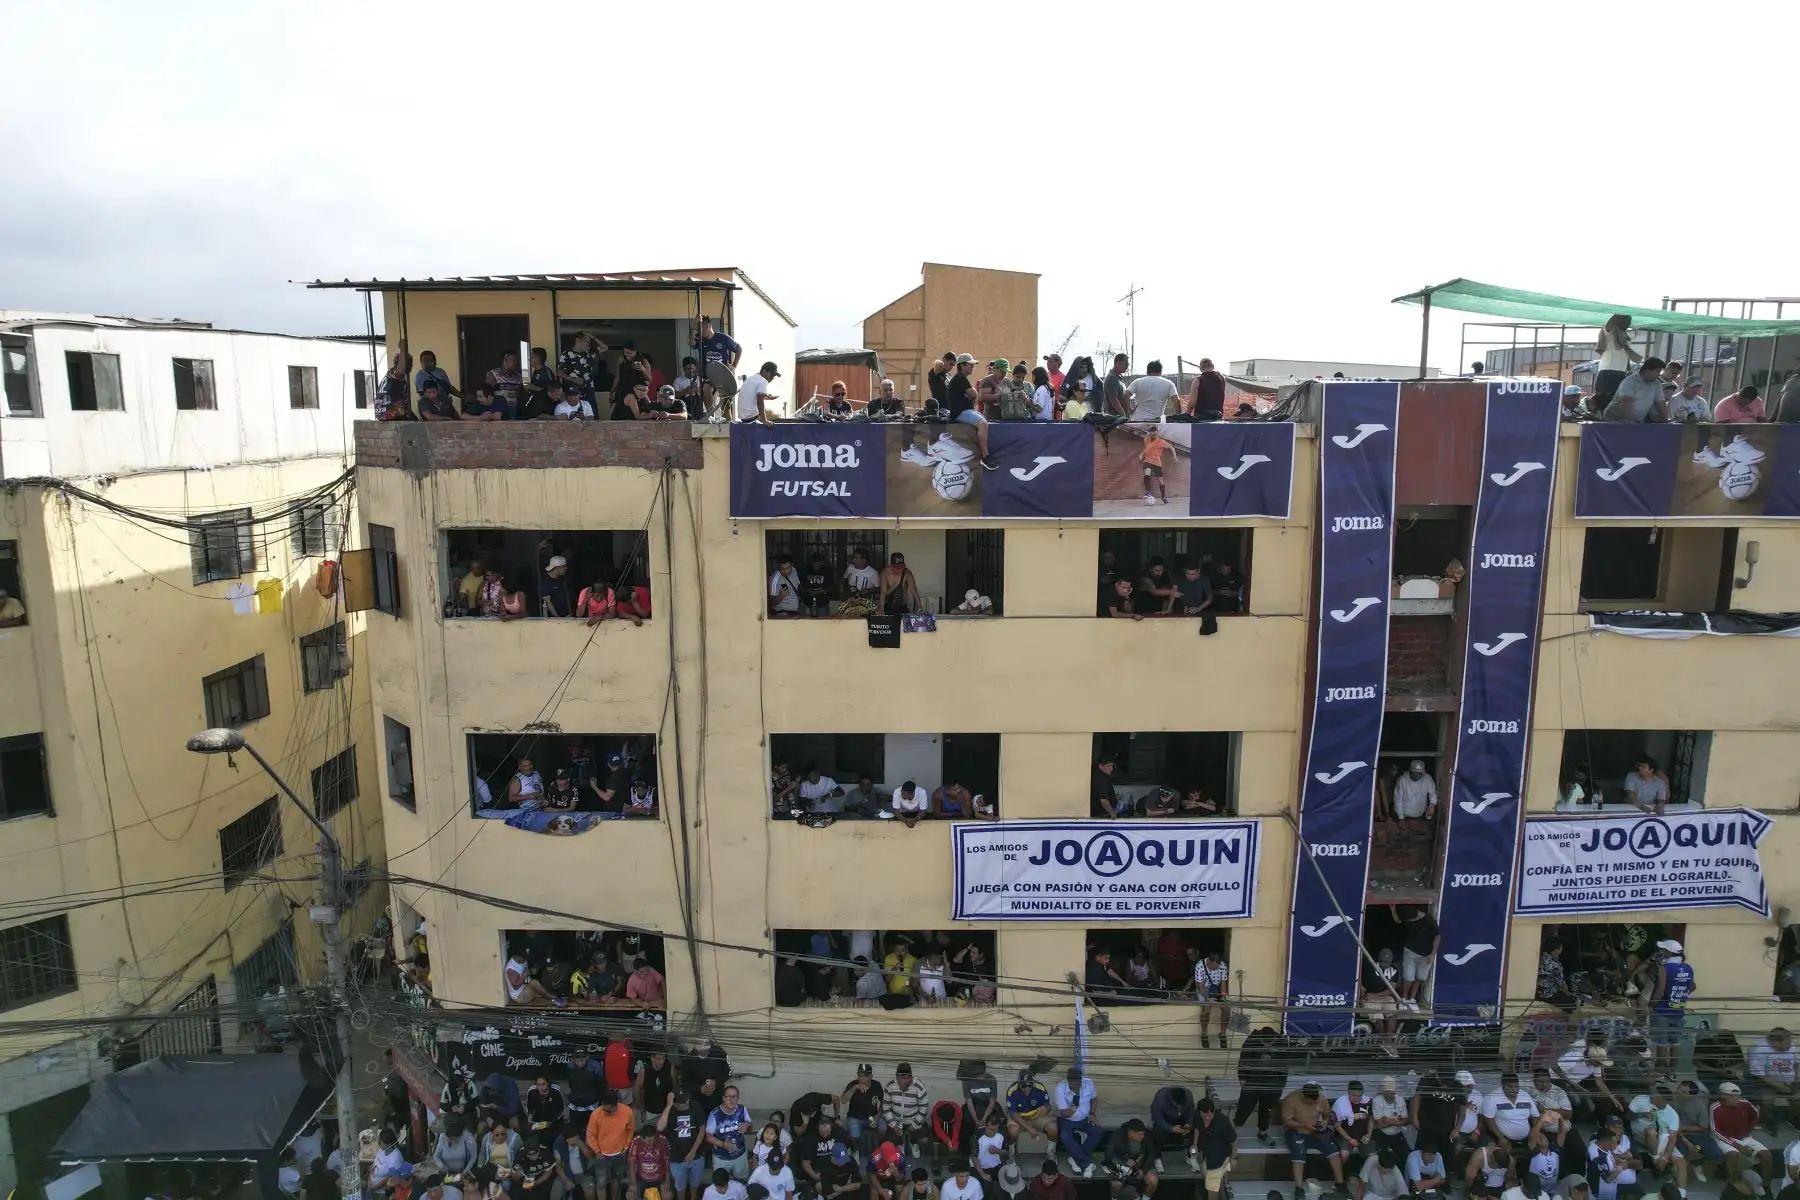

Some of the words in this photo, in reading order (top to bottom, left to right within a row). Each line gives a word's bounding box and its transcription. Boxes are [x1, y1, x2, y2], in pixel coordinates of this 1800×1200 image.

[769, 480, 852, 497] FUTSAL
[1547, 832, 1581, 840] AMIGOS
[967, 845, 986, 853] LOS
[988, 844, 1028, 852] AMIGOS
[1028, 836, 1241, 872] JOAQUIN
[1004, 853, 1017, 861] DE
[1526, 865, 1573, 876] CONFÍA
[1575, 864, 1593, 873] EN
[1597, 863, 1609, 872] TI
[1613, 861, 1656, 871] MISMO
[1660, 860, 1668, 869] Y
[1672, 859, 1690, 868] EN
[1693, 858, 1711, 867] TU
[1715, 857, 1760, 873] EQUIPO
[1552, 877, 1602, 887] JUNTOS
[1606, 873, 1658, 884] PUEDEN
[968, 883, 1009, 894] JUEGA
[1014, 883, 1041, 892] CON
[1045, 881, 1092, 892] PASIÓN
[1097, 883, 1106, 892] Y
[1109, 883, 1146, 893] GANA
[1149, 883, 1177, 892] CON
[1180, 881, 1241, 893] ORGULLO
[1548, 889, 1627, 902] MUNDIALITO
[1631, 888, 1647, 898] DE
[1651, 887, 1667, 897] EL
[1670, 884, 1735, 896] PORVENIR
[1011, 901, 1092, 910] MUNDIALITO
[1095, 901, 1113, 910] DE
[1116, 901, 1132, 910] EL
[1136, 900, 1201, 910] PORVENIR
[528, 1035, 562, 1049] Teatro
[481, 1043, 506, 1057] CINE
